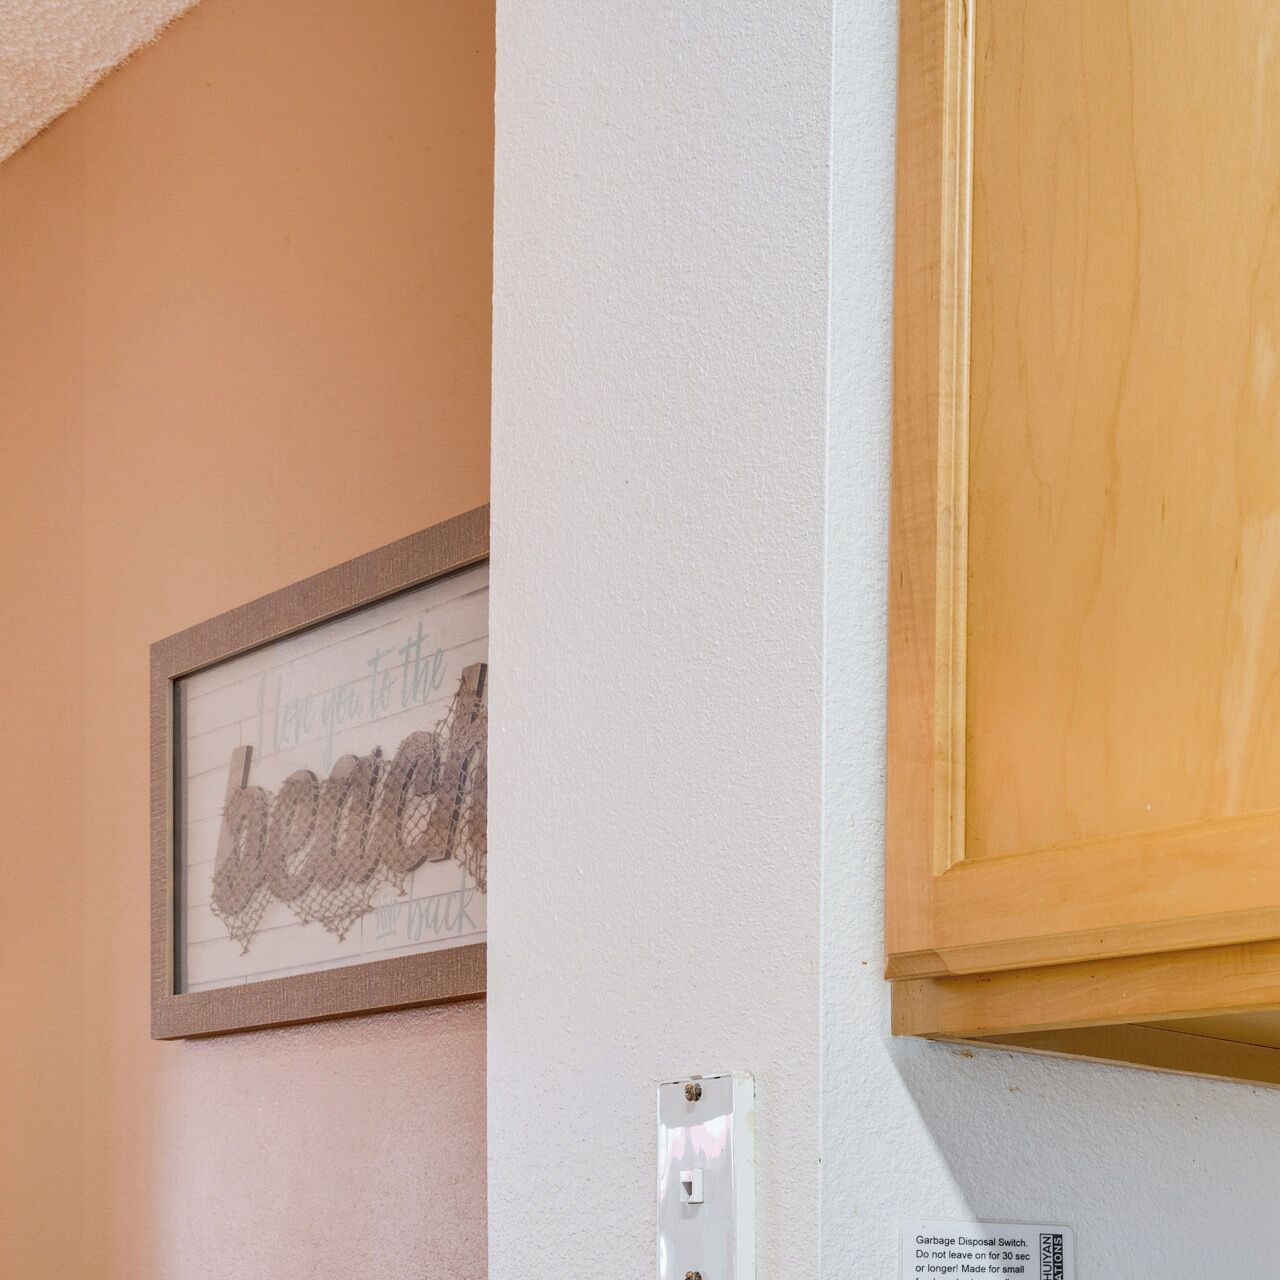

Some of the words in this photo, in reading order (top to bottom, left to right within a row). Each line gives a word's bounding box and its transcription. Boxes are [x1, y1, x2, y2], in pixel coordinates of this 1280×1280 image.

[367, 646, 396, 718] to
[400, 620, 447, 709] the
[916, 1236, 955, 1246] Garbage
[958, 1237, 996, 1246] Disposal
[998, 1238, 1028, 1247] Switch.
[916, 1250, 929, 1258] Do
[932, 1251, 946, 1259] not
[949, 1251, 972, 1260] leave
[988, 1252, 1000, 1260] for
[927, 1265, 958, 1274] longer!
[961, 1265, 986, 1273] Made
[989, 1265, 1000, 1273] for
